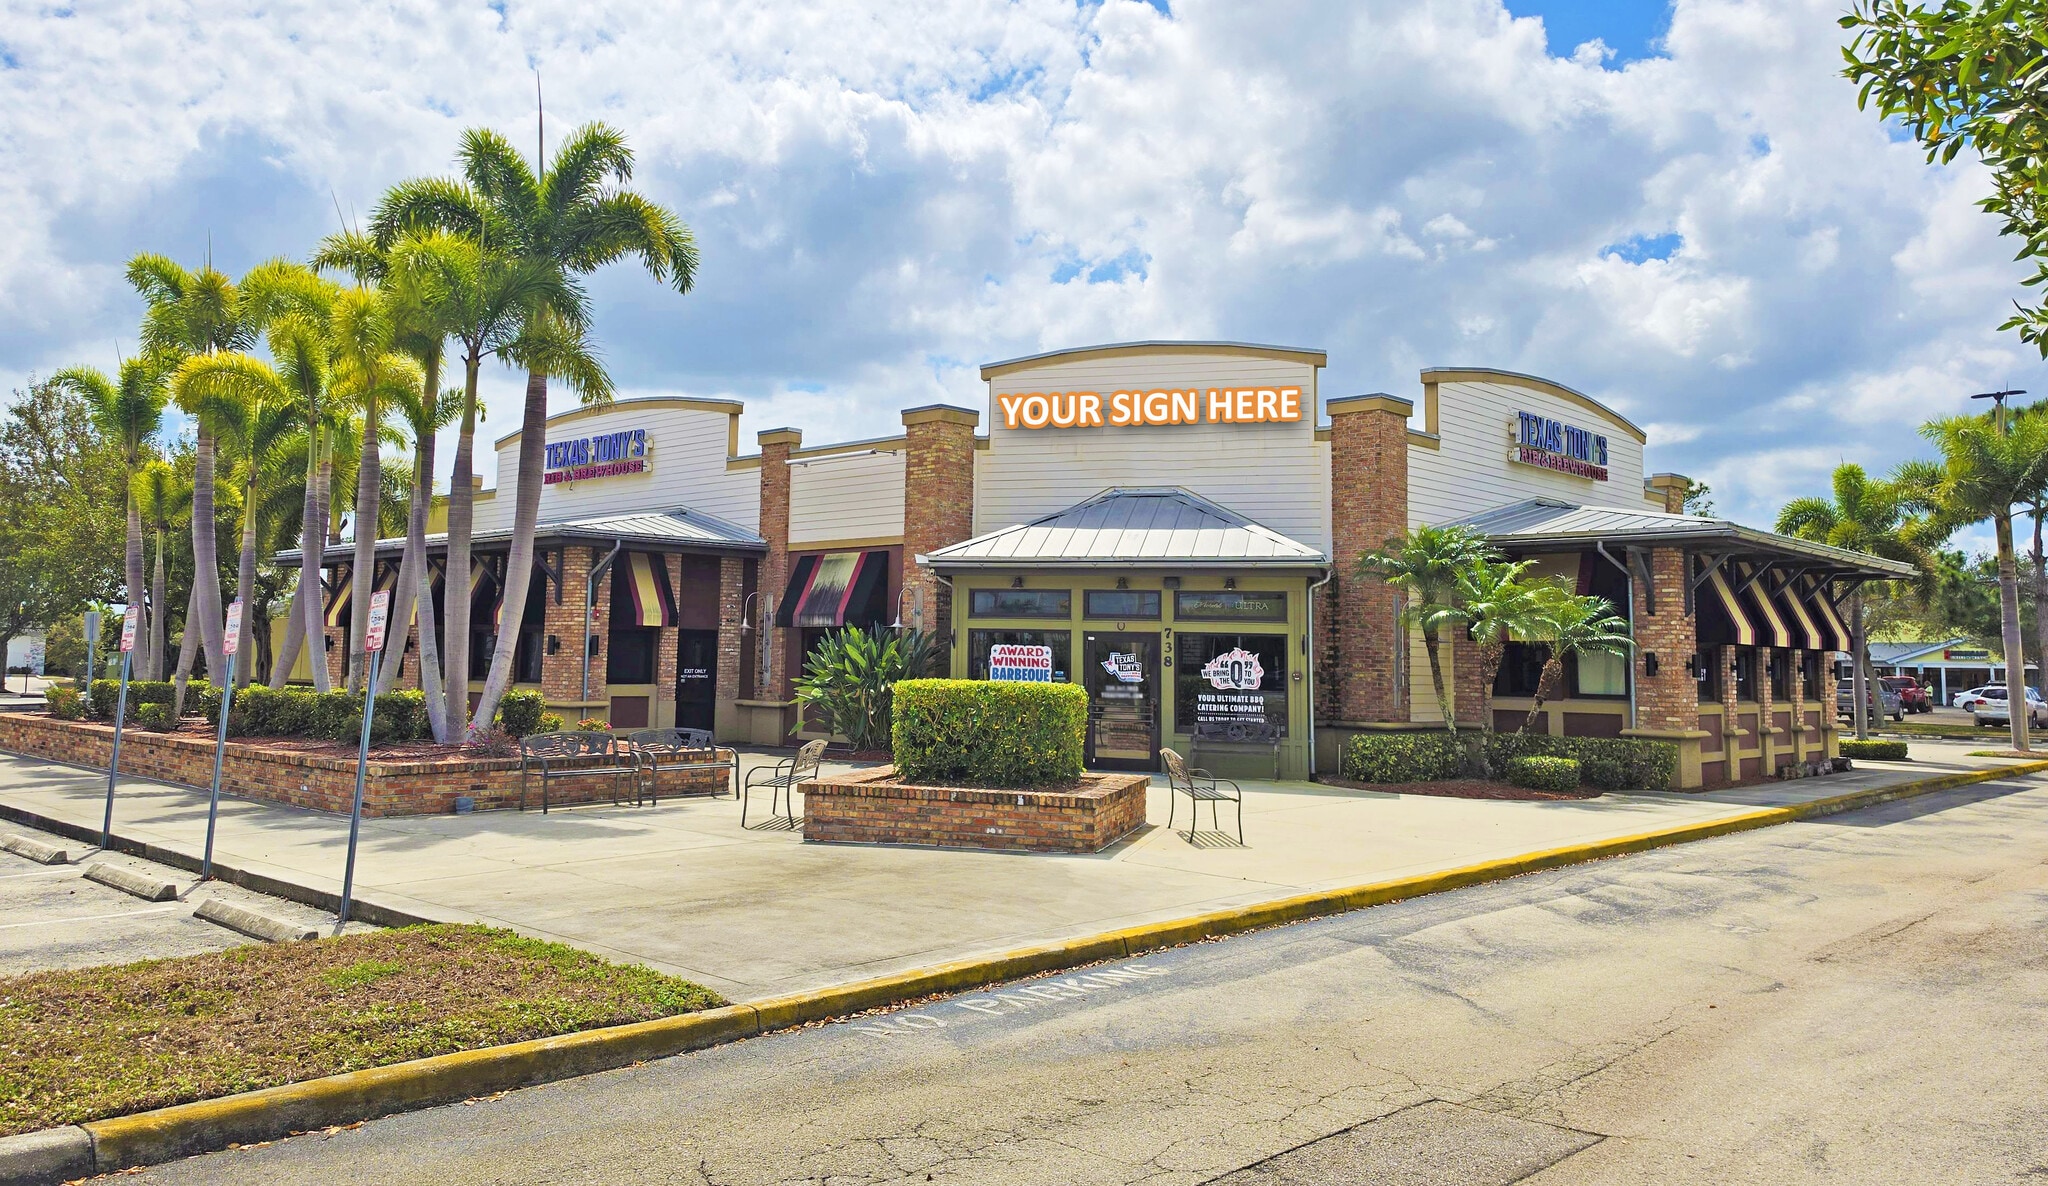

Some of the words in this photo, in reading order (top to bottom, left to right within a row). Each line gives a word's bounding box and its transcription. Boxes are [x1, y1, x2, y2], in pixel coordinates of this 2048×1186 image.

[1519, 411, 1563, 453] TEXAS
[1565, 425, 1608, 466] TONY'S
[545, 437, 590, 470] TEXAS
[592, 428, 646, 463] TONY'S
[1520, 446, 1540, 467] RIB
[1540, 450, 1549, 468] &
[1549, 454, 1608, 481] BREWHOUSE
[544, 471, 563, 485] RIB
[564, 470, 573, 482] &
[573, 460, 644, 481] BREWHOUSE
[1235, 602, 1269, 610] ULTRA
[998, 646, 1044, 657] AWARD
[1164, 627, 1173, 668] 738
[992, 656, 1050, 668] WINNING
[1115, 655, 1135, 663] TEXAS
[1120, 663, 1141, 671] TONY'S
[1244, 670, 1252, 678] TO
[1217, 695, 1249, 703] ULTIMATE
[1250, 696, 1264, 705] BBQ
[1197, 704, 1229, 712] CATERING
[1230, 705, 1265, 713] COMPANY!
[850, 1013, 948, 1039] NO
[954, 963, 1170, 1015] PARKING
